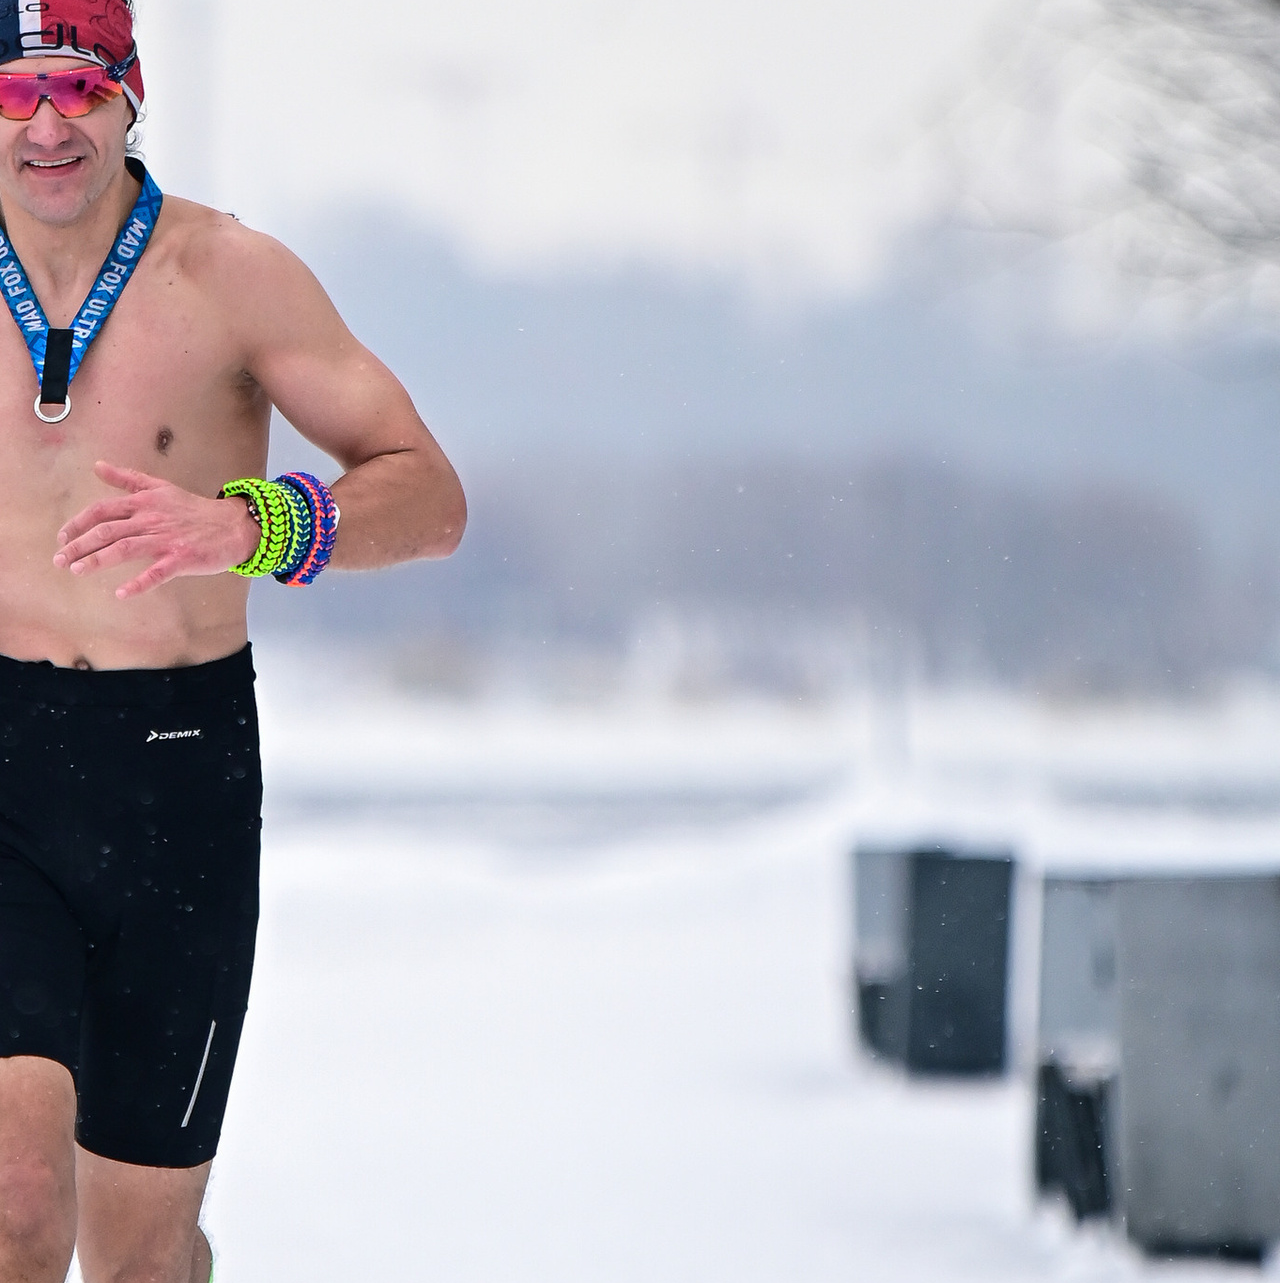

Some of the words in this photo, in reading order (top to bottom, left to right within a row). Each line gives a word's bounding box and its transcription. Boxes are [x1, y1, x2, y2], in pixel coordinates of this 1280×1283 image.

[116, 217, 147, 260] MAD
[96, 261, 128, 295] FOX
[16, 299, 46, 332] MAD
[72, 297, 108, 348] ULTRA
[158, 729, 201, 740] DEMIX
